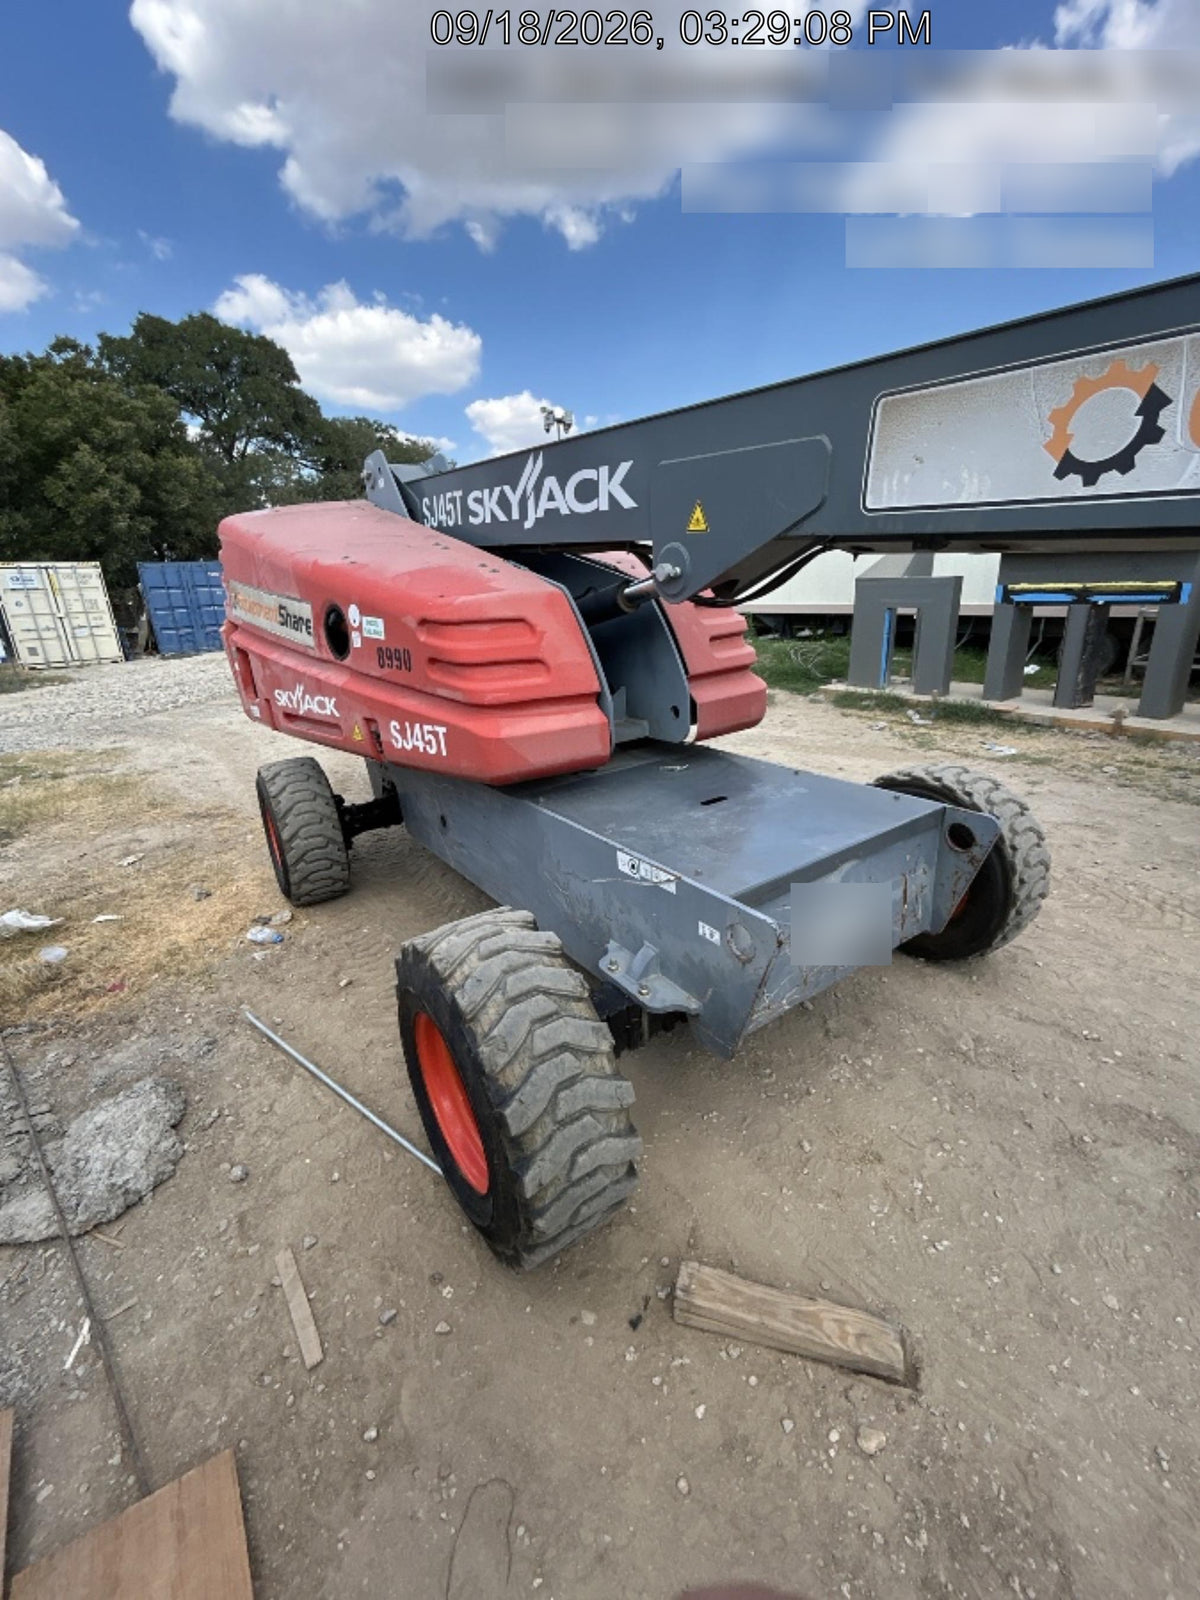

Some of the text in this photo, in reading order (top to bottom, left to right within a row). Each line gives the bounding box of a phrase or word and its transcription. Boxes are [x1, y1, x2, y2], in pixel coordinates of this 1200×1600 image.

[423, 452, 638, 529] SJ45T SKYJACK
[376, 647, 412, 672] 8990
[274, 684, 340, 717] SKYJACK
[390, 720, 447, 756] SJ45T
